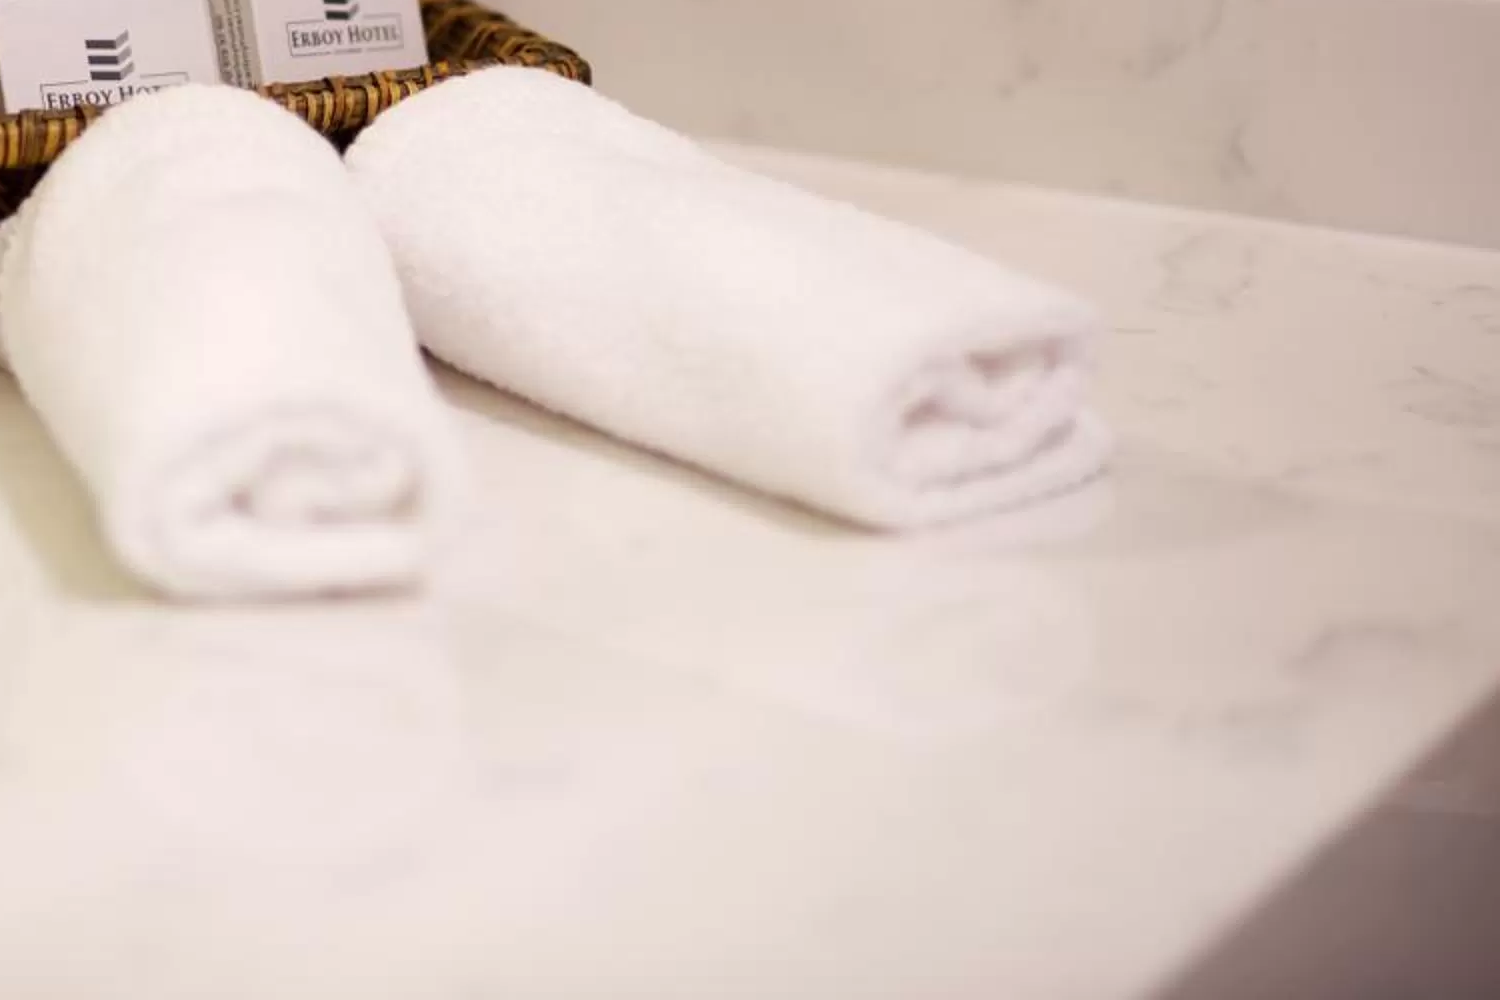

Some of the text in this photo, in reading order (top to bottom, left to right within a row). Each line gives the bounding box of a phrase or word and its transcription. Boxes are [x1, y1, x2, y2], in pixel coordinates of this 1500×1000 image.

[291, 24, 398, 48] ERBOY HOTEL
[47, 89, 113, 110] ERBOY
